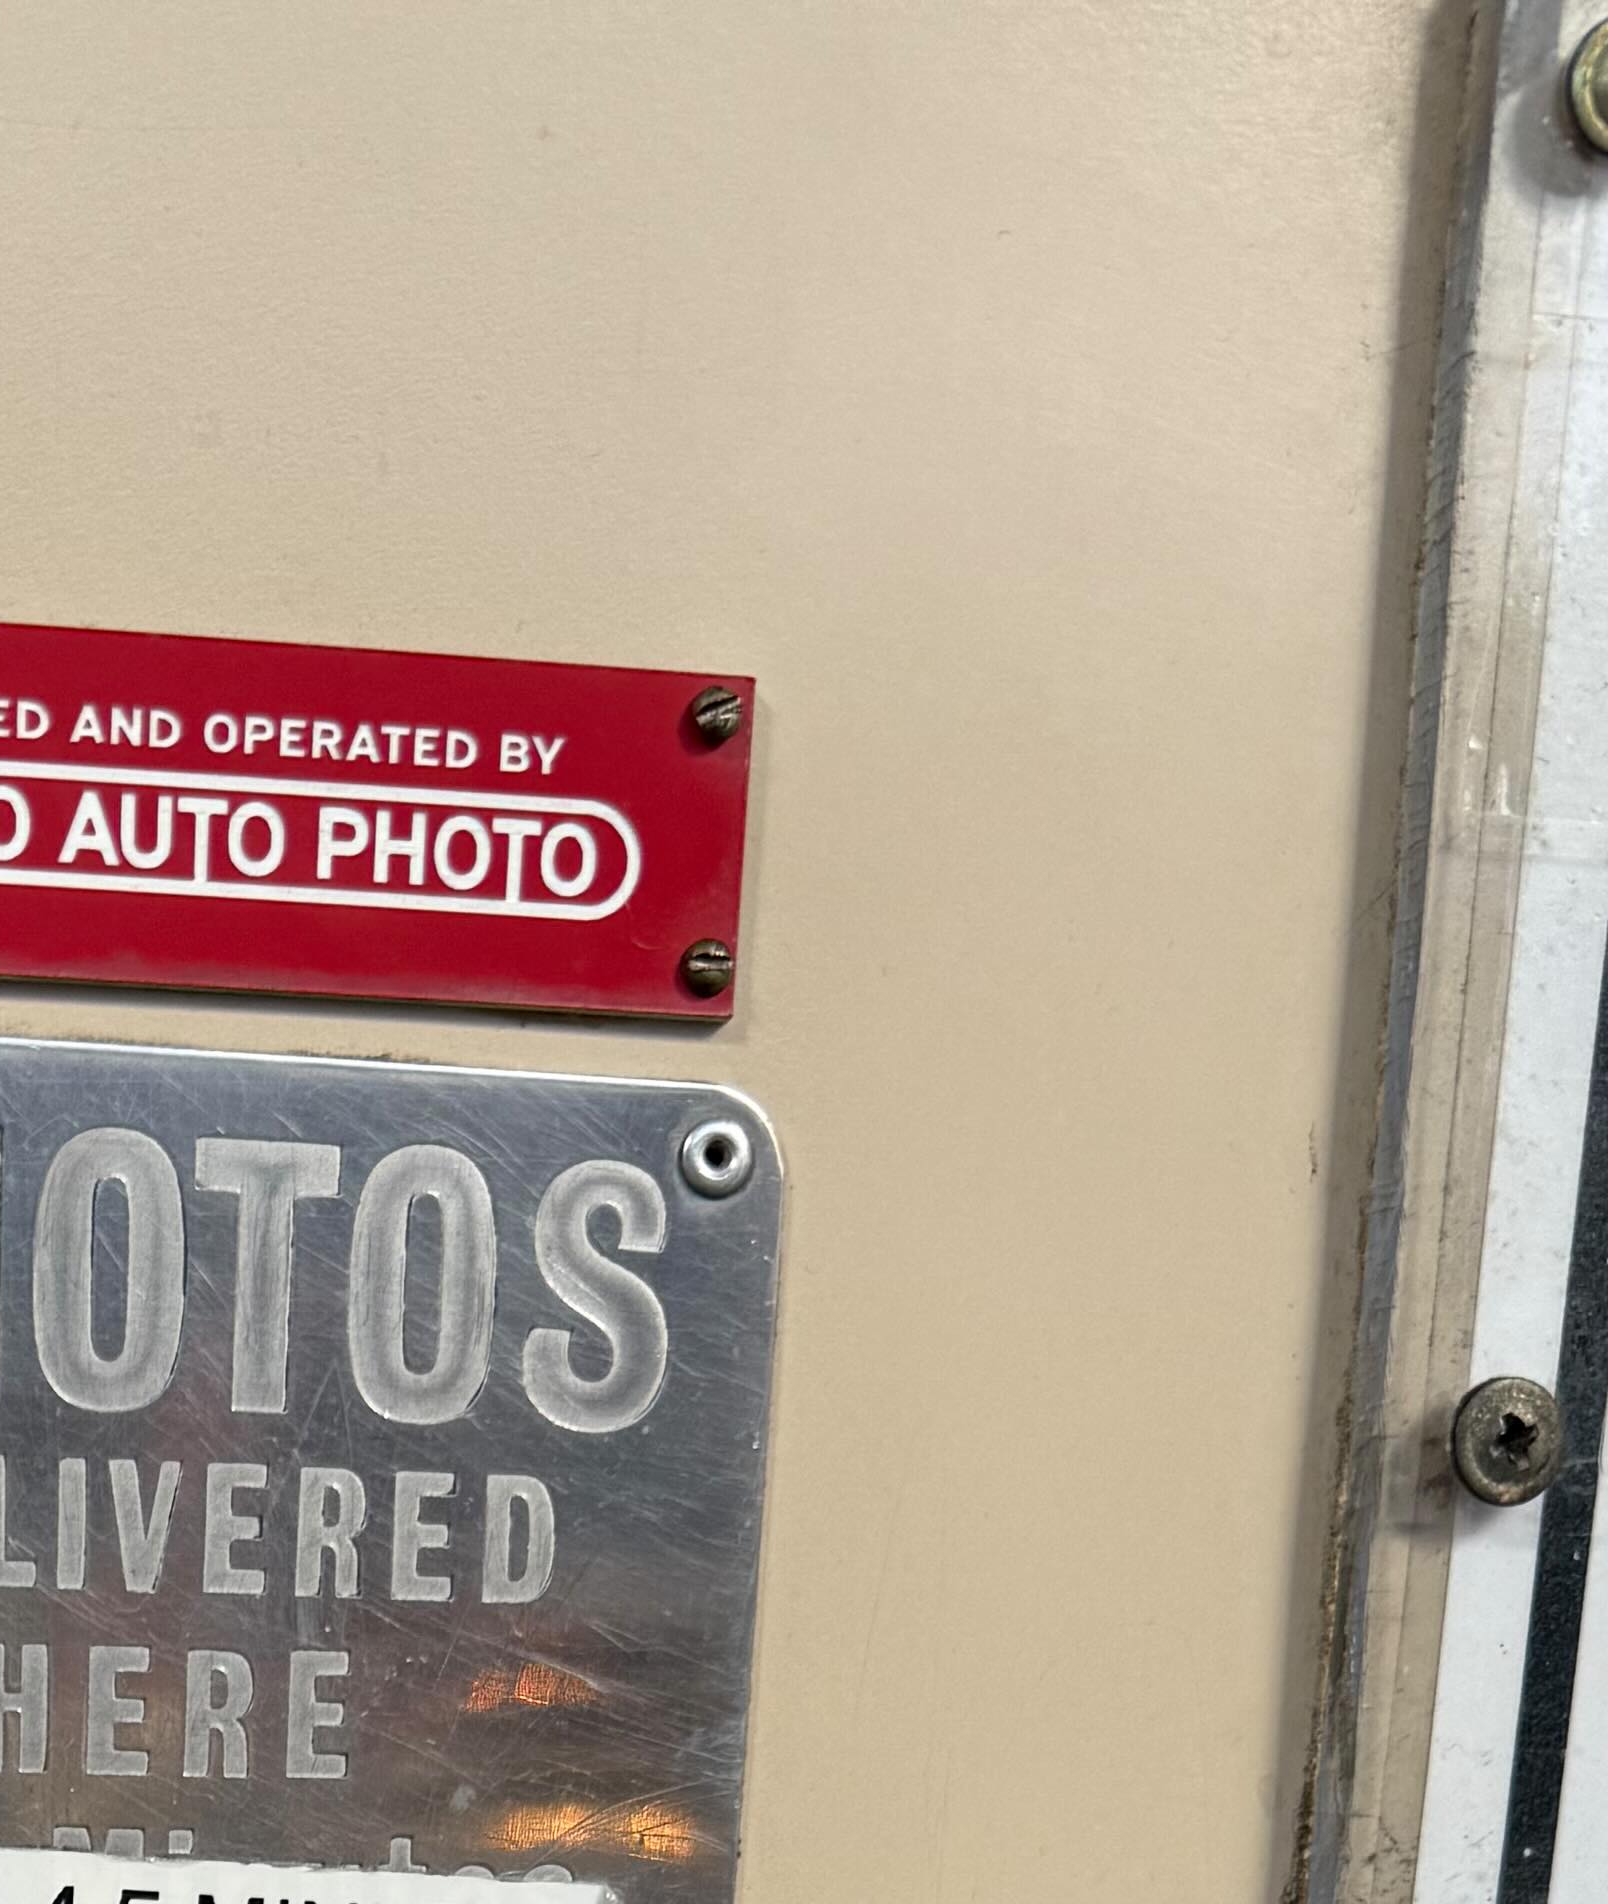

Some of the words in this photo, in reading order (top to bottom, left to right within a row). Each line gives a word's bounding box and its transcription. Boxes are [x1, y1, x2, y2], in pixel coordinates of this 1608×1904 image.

[69, 705, 182, 749] AND
[203, 712, 479, 769] OPERATED
[498, 732, 566, 775] BY
[57, 789, 286, 883] AUTO
[316, 805, 597, 904] PHOTO
